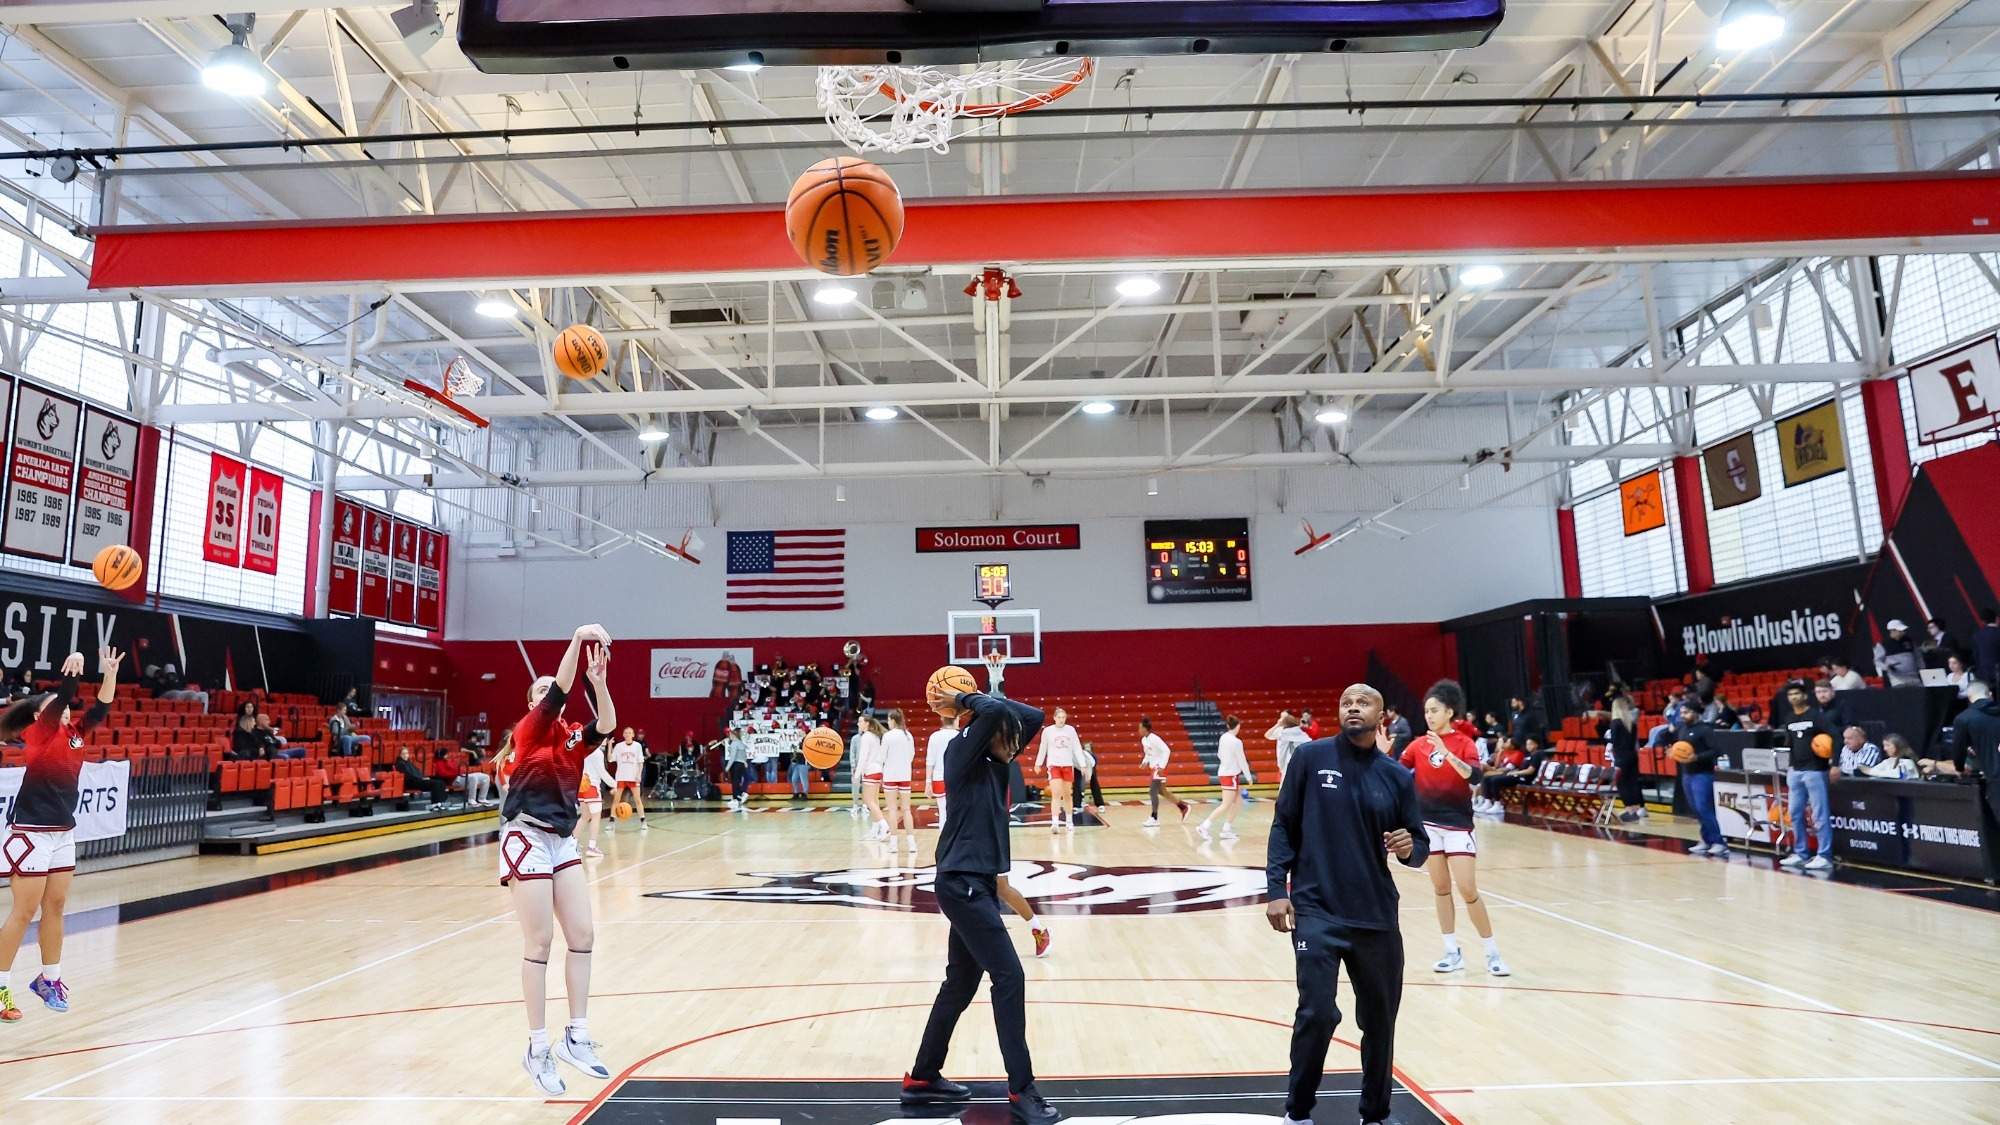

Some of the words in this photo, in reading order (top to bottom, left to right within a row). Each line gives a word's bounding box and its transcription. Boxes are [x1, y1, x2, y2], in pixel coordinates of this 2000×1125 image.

[1940, 359, 1989, 425] E
[16, 453, 51, 470] AMERICA
[51, 463, 70, 475] EAST
[15, 465, 69, 489] CHAMPIONS
[17, 488, 38, 504] 1985
[43, 495, 63, 511] 1986
[83, 488, 127, 509] CHAMPIONS
[14, 507, 36, 522] 1987
[42, 513, 61, 528] 1989
[84, 505, 102, 520] 1985
[215, 500, 234, 527] 35
[82, 523, 101, 537] 1987
[258, 512, 272, 538] 10
[214, 530, 232, 542] LEWIS
[934, 531, 1006, 547] Solomon
[1013, 530, 1061, 545] Court
[1185, 541, 1214, 553] 15:03
[1238, 550, 1246, 561] 0
[1161, 551, 1169, 563] 0
[982, 577, 1005, 596] 30
[1682, 608, 1842, 656] #HowlinHuskies
[1852, 801, 1866, 810] THE
[1829, 816, 1897, 836] COLONNADE
[1850, 839, 1878, 850] BOSTON
